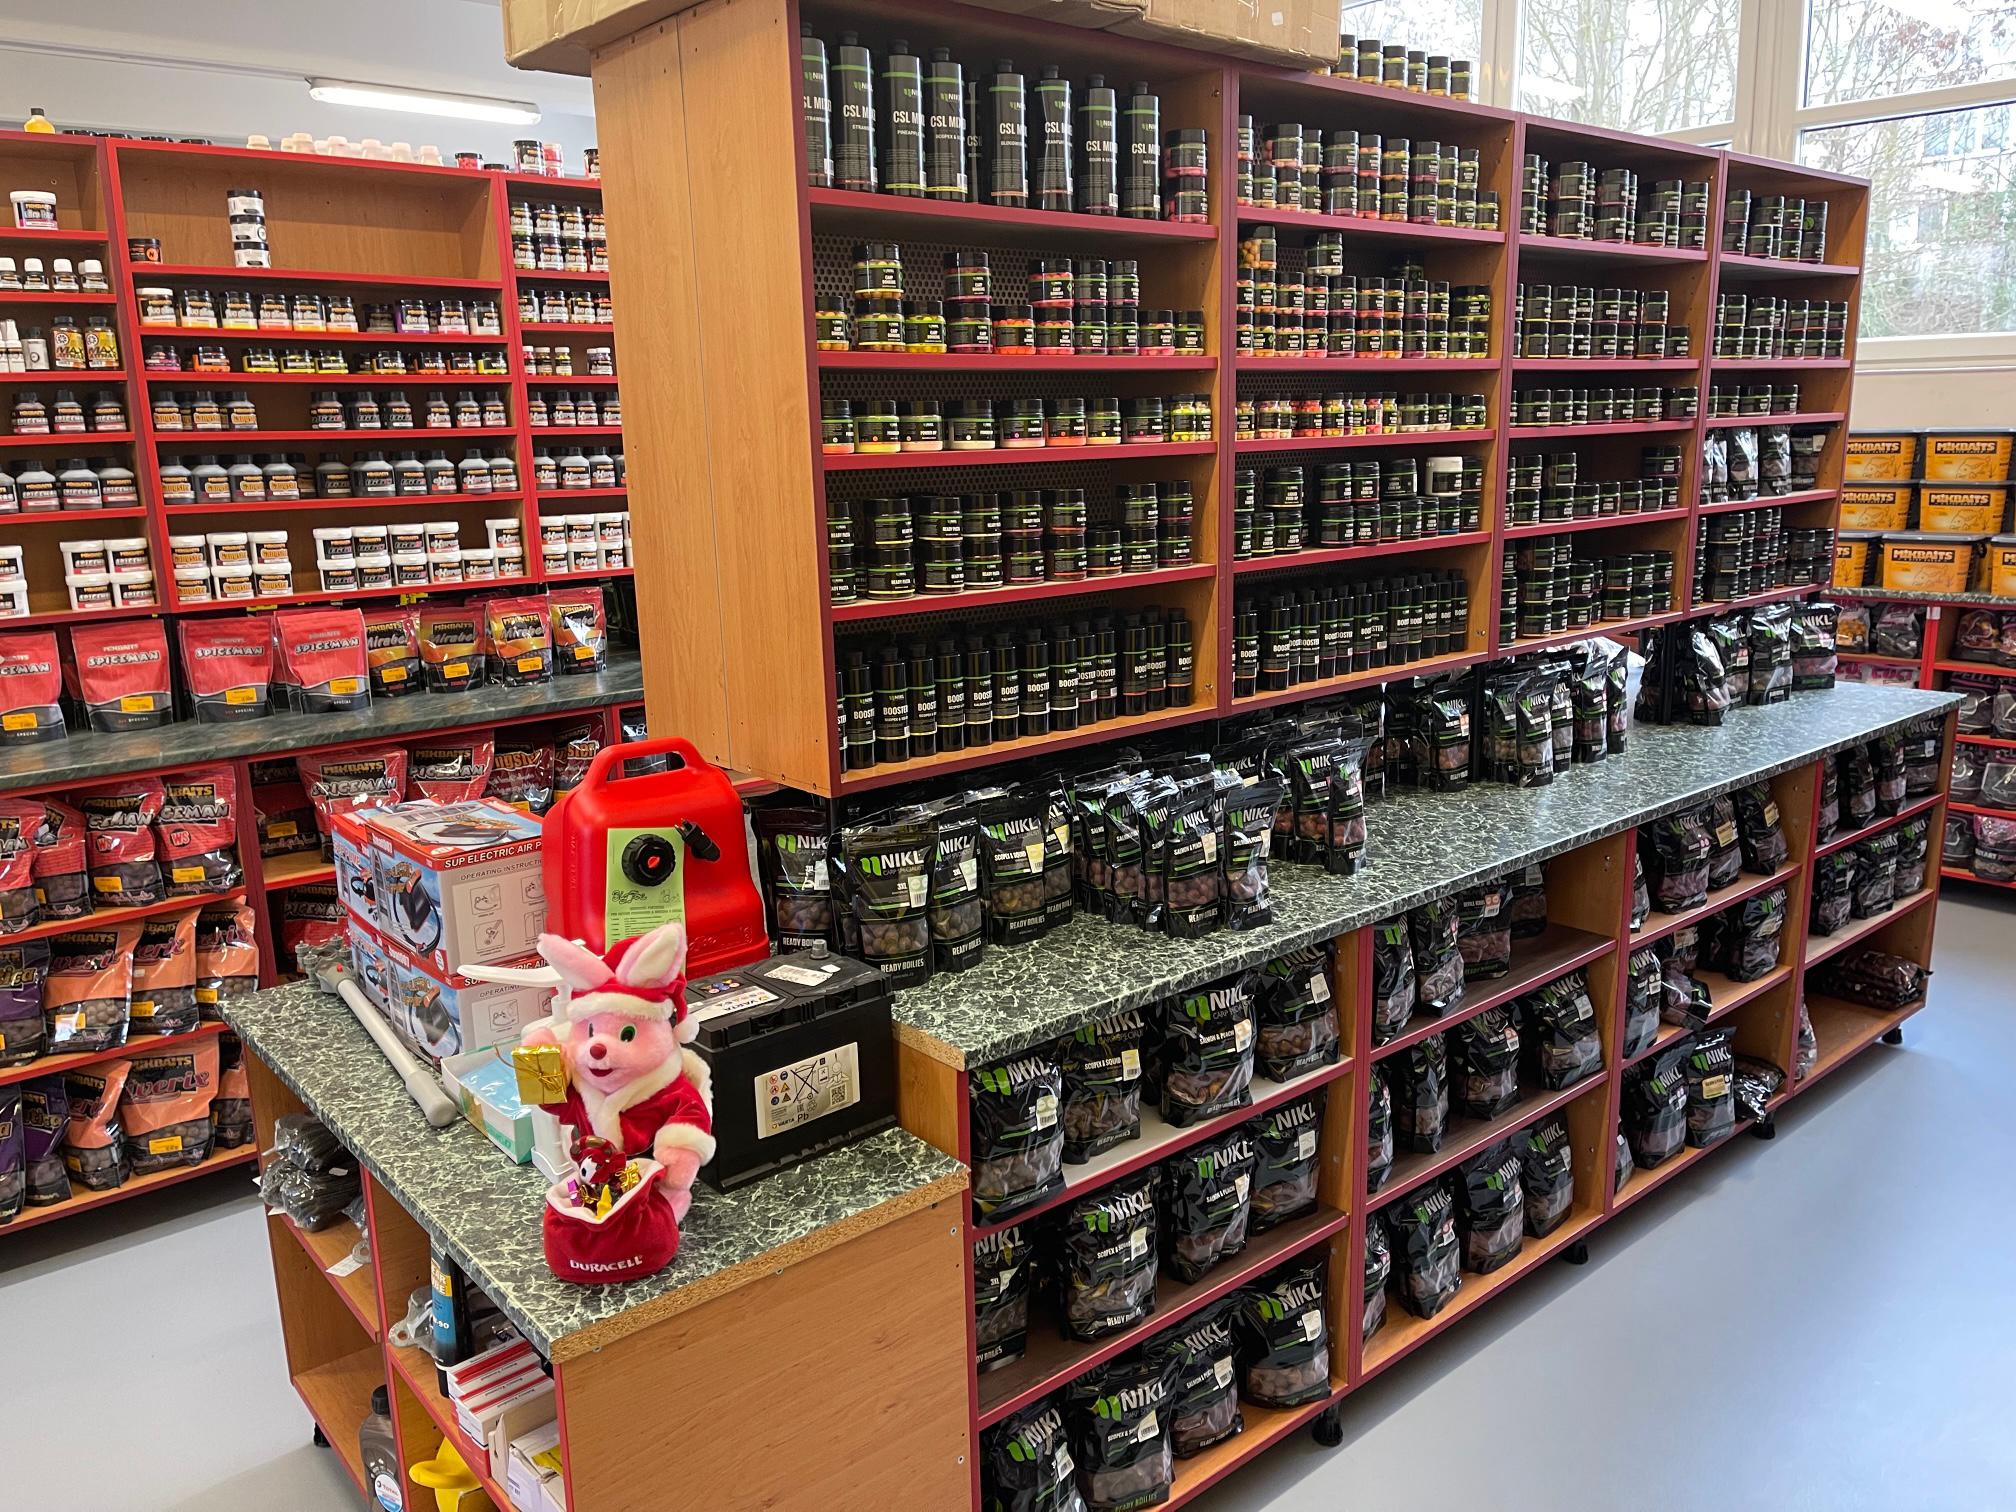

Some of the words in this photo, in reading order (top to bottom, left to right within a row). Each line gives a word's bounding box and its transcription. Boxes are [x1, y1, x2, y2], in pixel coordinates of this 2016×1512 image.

[803, 95, 812, 109] SL
[843, 104, 861, 118] CSL
[893, 110, 911, 123] CSL
[930, 115, 948, 128] CSL
[1000, 123, 1015, 134] CSL
[1044, 121, 1060, 133] CSL
[1086, 141, 1101, 152] CSL
[1132, 143, 1146, 154] CSL
[1846, 442, 1900, 452] MIKBAITS
[1937, 442, 1996, 451] MIKBAITS
[1841, 493, 1895, 502] MIKBAITS
[1931, 494, 1989, 504] MIKBAITS
[1894, 550, 1954, 561] MIKBAITS
[1801, 615, 1833, 627] NIKL
[195, 646, 264, 659] SPICEMAN
[295, 638, 360, 655] SPICEMAN
[88, 650, 160, 667] SPICEMAN
[0, 664, 50, 675] CEMAN
[1028, 682, 1049, 692] BOOSTE
[1059, 678, 1078, 688] BOOST
[974, 690, 992, 700] BOOST
[1001, 686, 1019, 695] BOOST
[947, 693, 964, 703] BOOST
[883, 705, 908, 715] BOOSTE
[918, 701, 936, 711] BOOST
[854, 708, 874, 719] BOOST
[323, 762, 384, 775] MIKBAITS
[1311, 755, 1331, 769] NIK
[168, 786, 213, 797] BAITS
[311, 777, 397, 797] SPICEMAN
[161, 804, 229, 820] CEMAN
[1182, 809, 1209, 828] NIKL
[1243, 807, 1272, 823] NIKL
[1004, 817, 1039, 835] NIKL
[797, 835, 828, 849] NIK
[940, 835, 971, 856] NIKL
[445, 857, 465, 868] SUP
[468, 848, 515, 864] ELECTRIC
[517, 844, 533, 854] AIR
[881, 851, 924, 869] NIKL
[460, 867, 501, 881] OPERATING
[503, 859, 542, 872] INSTRUCTI
[285, 903, 348, 917] PICEMAN
[1009, 920, 1026, 930] READY
[881, 963, 902, 973] READY
[903, 957, 924, 970] BOILIES
[1210, 987, 1249, 1011] NIKL
[1707, 1047, 1731, 1064] NIKL
[1084, 1061, 1102, 1070] SCOPEX
[1106, 1057, 1121, 1066] SQUID
[1007, 1057, 1050, 1085] NIKL
[1659, 1067, 1682, 1088] NIKL
[1276, 1102, 1316, 1130] NIKL
[1541, 1122, 1565, 1145] NIKL
[1213, 1142, 1254, 1170] NIKL
[1108, 1193, 1152, 1223] NIKL
[1424, 1189, 1451, 1215] NIKL
[975, 1227, 1025, 1258] NIKL
[570, 1257, 640, 1273] DURACELL
[431, 1266, 446, 1284] EAR
[1278, 1282, 1322, 1311] NIKL
[1184, 1322, 1229, 1354] NIKL
[1120, 1382, 1167, 1412] NIKL
[1025, 1408, 1062, 1448] NIKL
